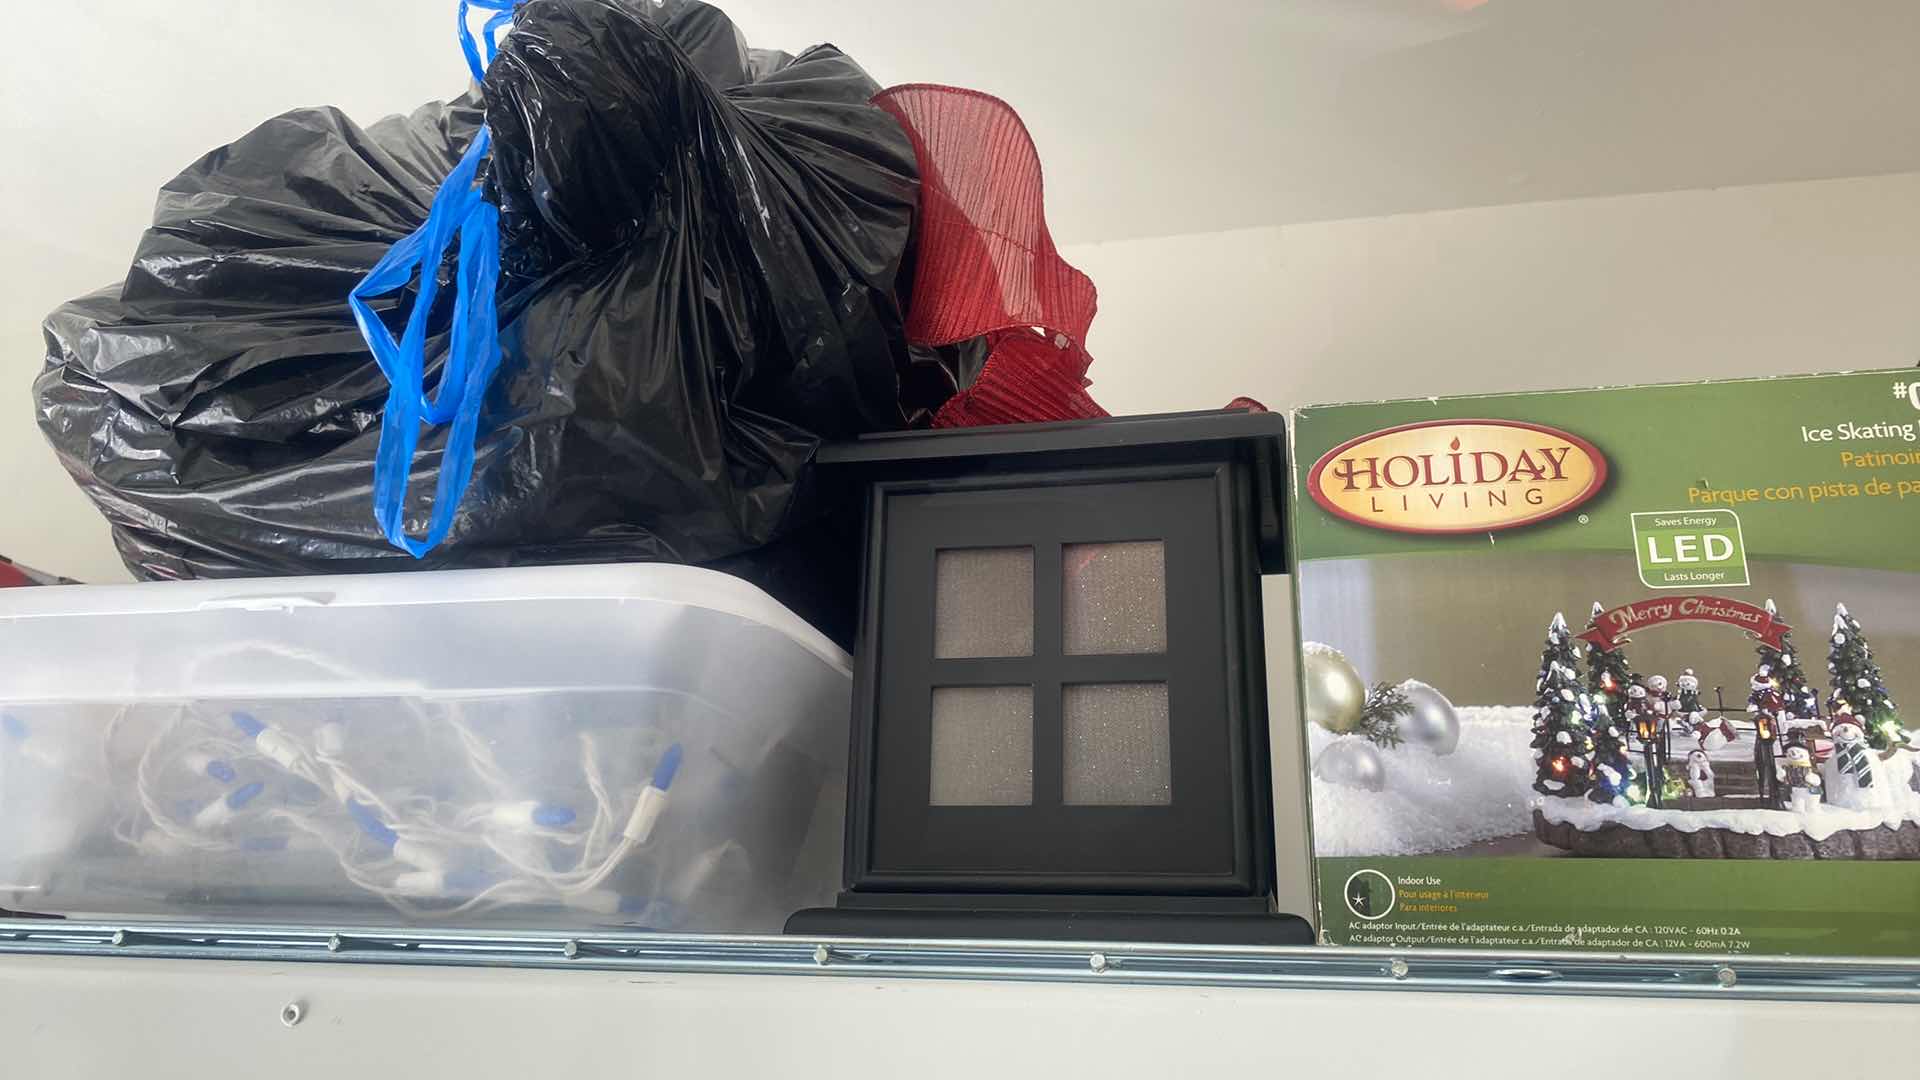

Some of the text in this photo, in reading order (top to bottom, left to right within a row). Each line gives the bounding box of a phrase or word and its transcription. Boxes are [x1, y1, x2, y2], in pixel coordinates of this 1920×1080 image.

[1801, 425, 1833, 442] Ice
[1837, 421, 1917, 442] Skating
[1334, 436, 1571, 490] HOLIDAY
[1371, 487, 1543, 513] LIVING
[1688, 476, 1920, 506] Parque con pista de pa
[1655, 516, 1717, 527] Saves Energy
[1647, 534, 1734, 563] LED
[1664, 571, 1725, 582] Lasts Longer
[1609, 598, 1763, 633] Merry Christmas
[1397, 876, 1441, 885] Indoor Use
[1349, 922, 1361, 930] AC
[1362, 921, 1393, 932] adaptor
[1449, 922, 1460, 932] de
[1623, 925, 1634, 934] de
[1655, 926, 1688, 935] 120VAC
[1695, 927, 1719, 935] 60Hz
[1363, 935, 1394, 945] adaptor
[1458, 935, 1469, 944] de
[1587, 938, 1630, 948] adaptador
[1633, 939, 1643, 947] de
[1665, 939, 1686, 948] 12VA
[1694, 940, 1727, 949] 600mA
